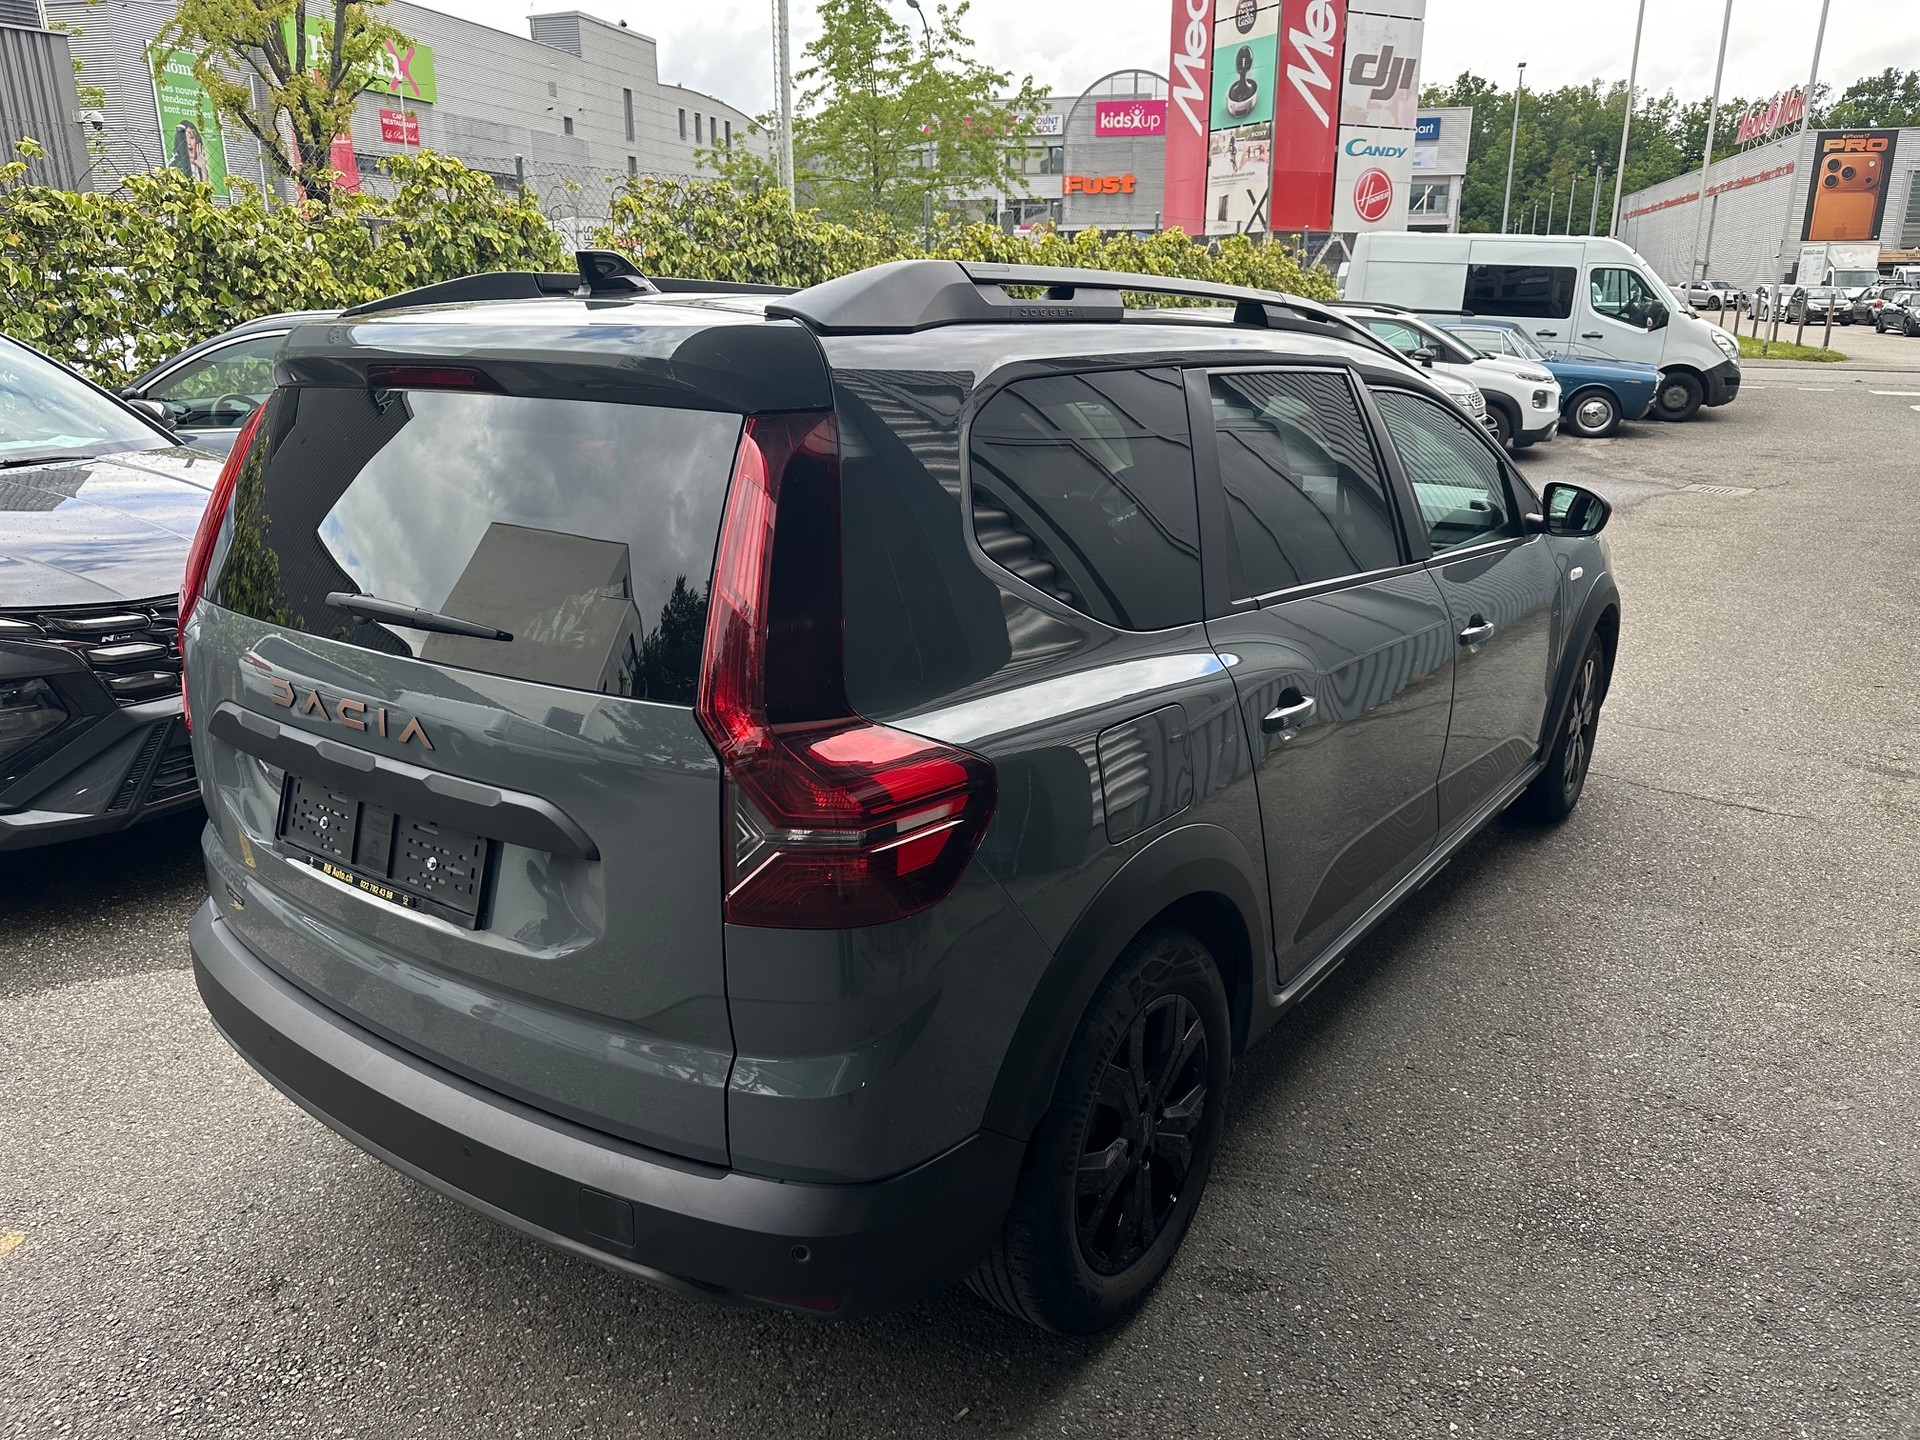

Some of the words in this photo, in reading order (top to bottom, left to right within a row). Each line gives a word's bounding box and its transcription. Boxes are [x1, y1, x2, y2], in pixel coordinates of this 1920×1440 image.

[1416, 124, 1434, 134] art
[1822, 138, 1889, 153] PRO
[1020, 308, 1075, 317] JOGGER
[270, 675, 435, 750] DACIA
[212, 851, 248, 893] JOGGER
